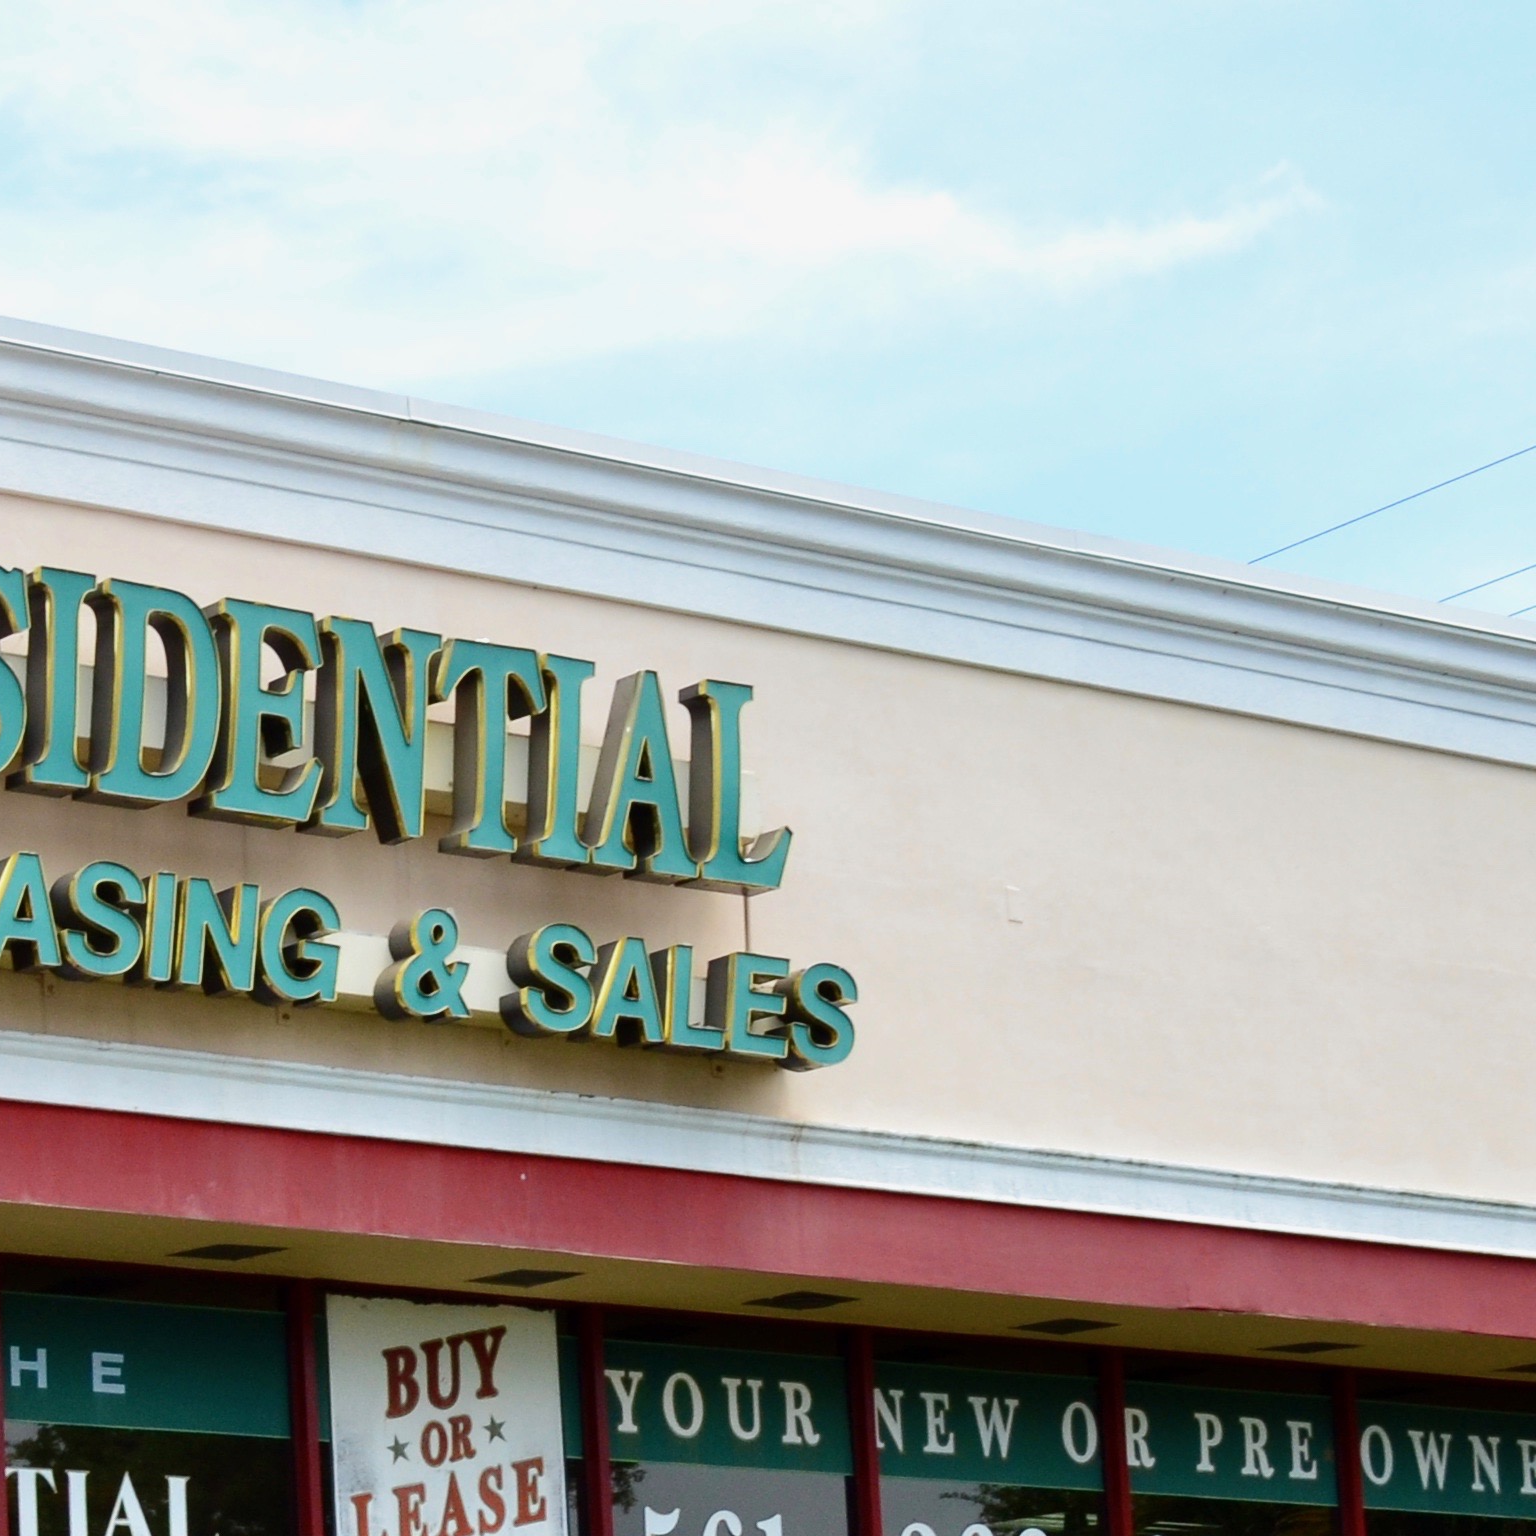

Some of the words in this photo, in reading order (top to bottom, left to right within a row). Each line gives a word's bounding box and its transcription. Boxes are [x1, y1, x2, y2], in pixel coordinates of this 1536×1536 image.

[376, 906, 469, 1022] &
[501, 922, 858, 1071] SALES
[382, 1325, 506, 1418] BUY
[419, 1414, 475, 1468] OR
[604, 1368, 821, 1446] YOUR
[874, 1388, 1019, 1459] NEW
[1061, 1401, 1156, 1469] OR
[1194, 1412, 1318, 1480] PRE
